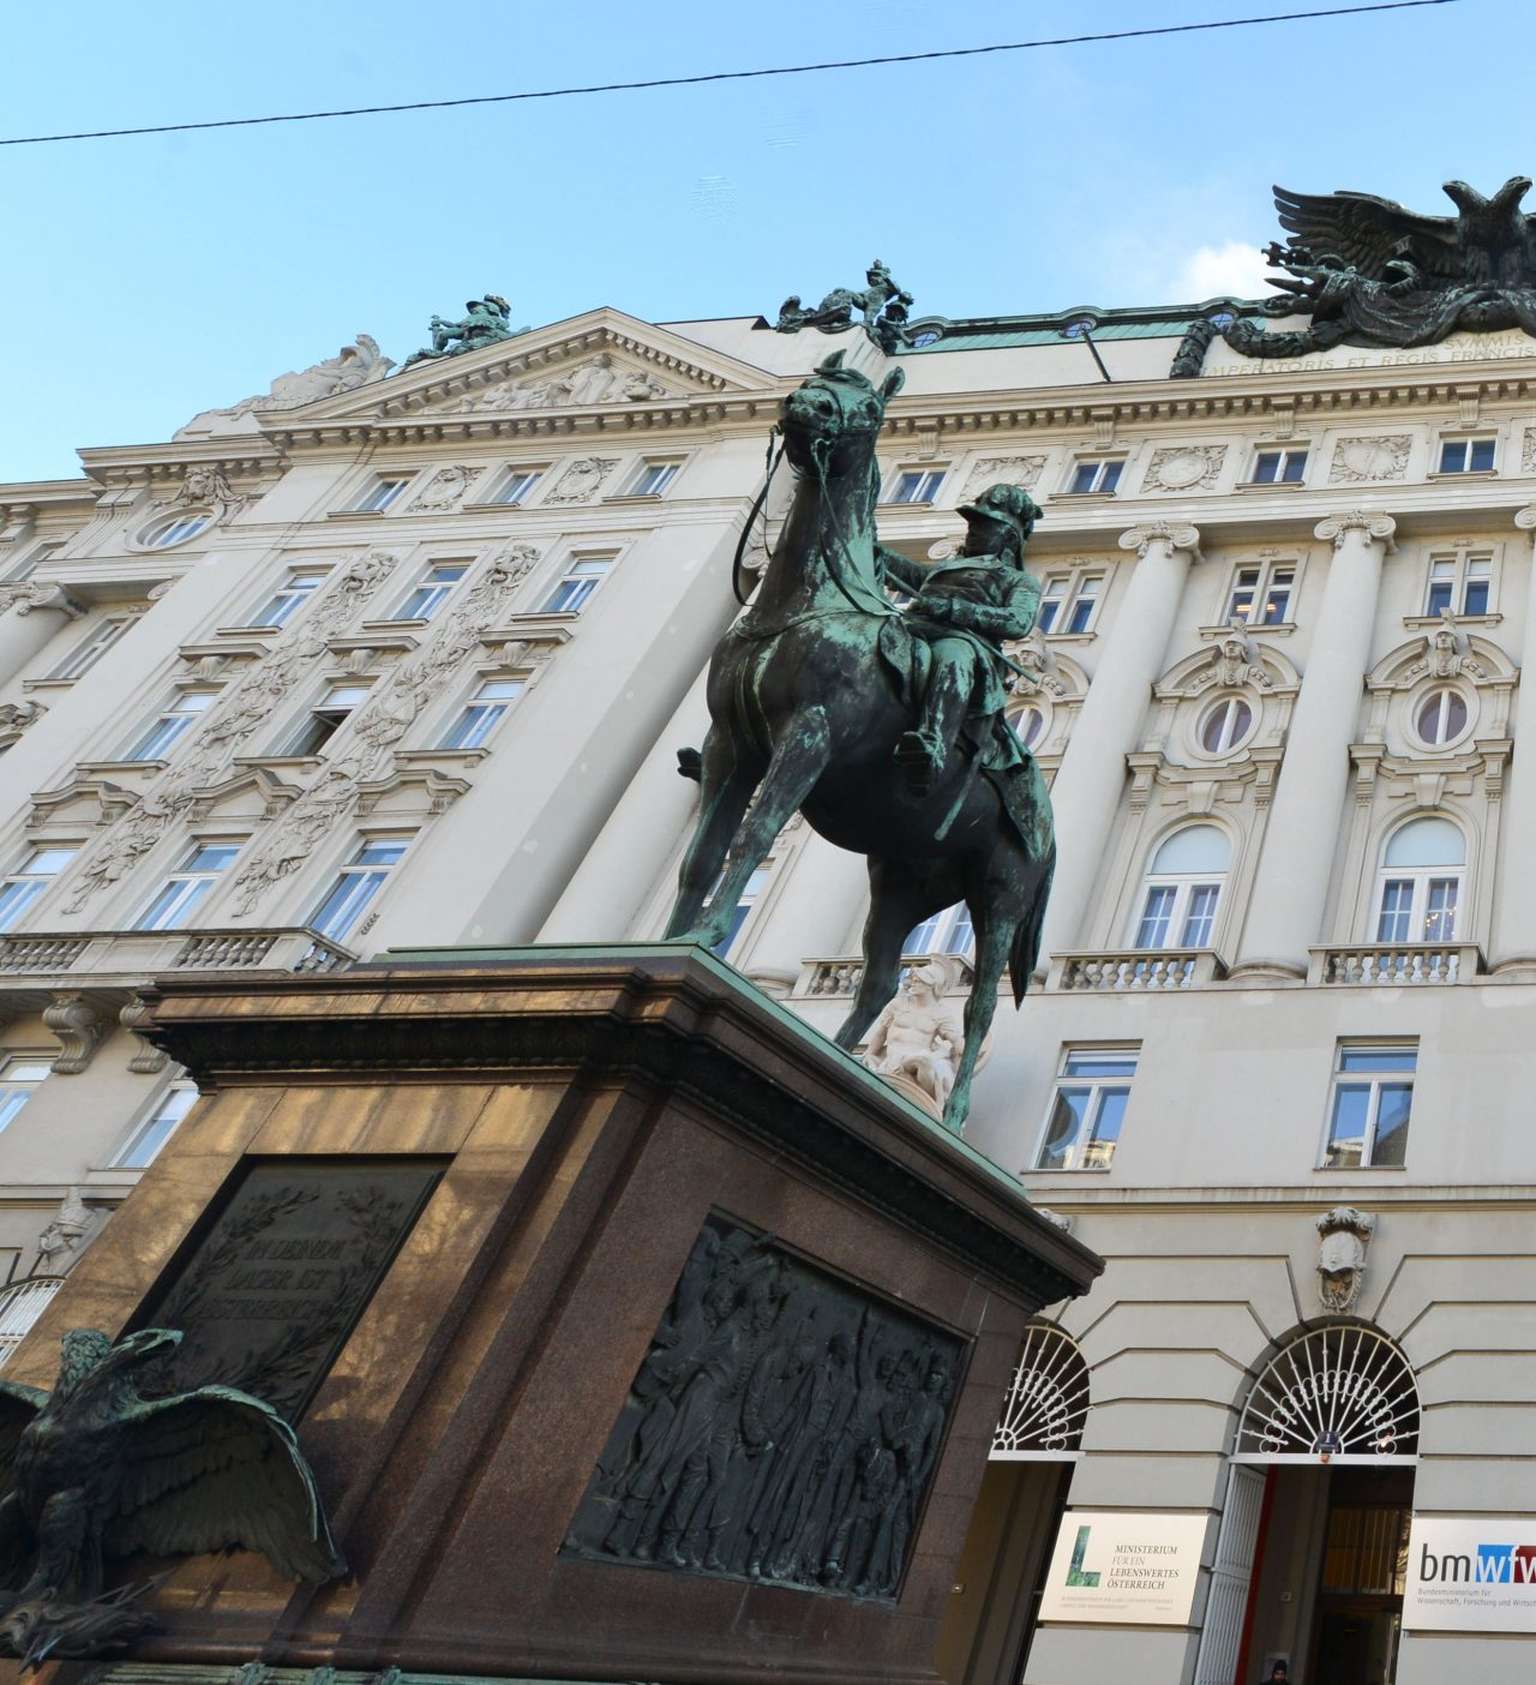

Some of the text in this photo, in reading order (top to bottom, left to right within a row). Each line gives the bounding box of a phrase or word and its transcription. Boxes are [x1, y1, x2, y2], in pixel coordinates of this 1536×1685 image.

[1346, 357, 1370, 368] ET
[1381, 352, 1439, 366] REGIS
[1114, 1545, 1178, 1555] MINISTERIUM
[1112, 1556, 1146, 1566] FÜR EIN
[1109, 1568, 1180, 1578] LEBENSWERTES
[1106, 1579, 1166, 1590] ÖSTERREICH
